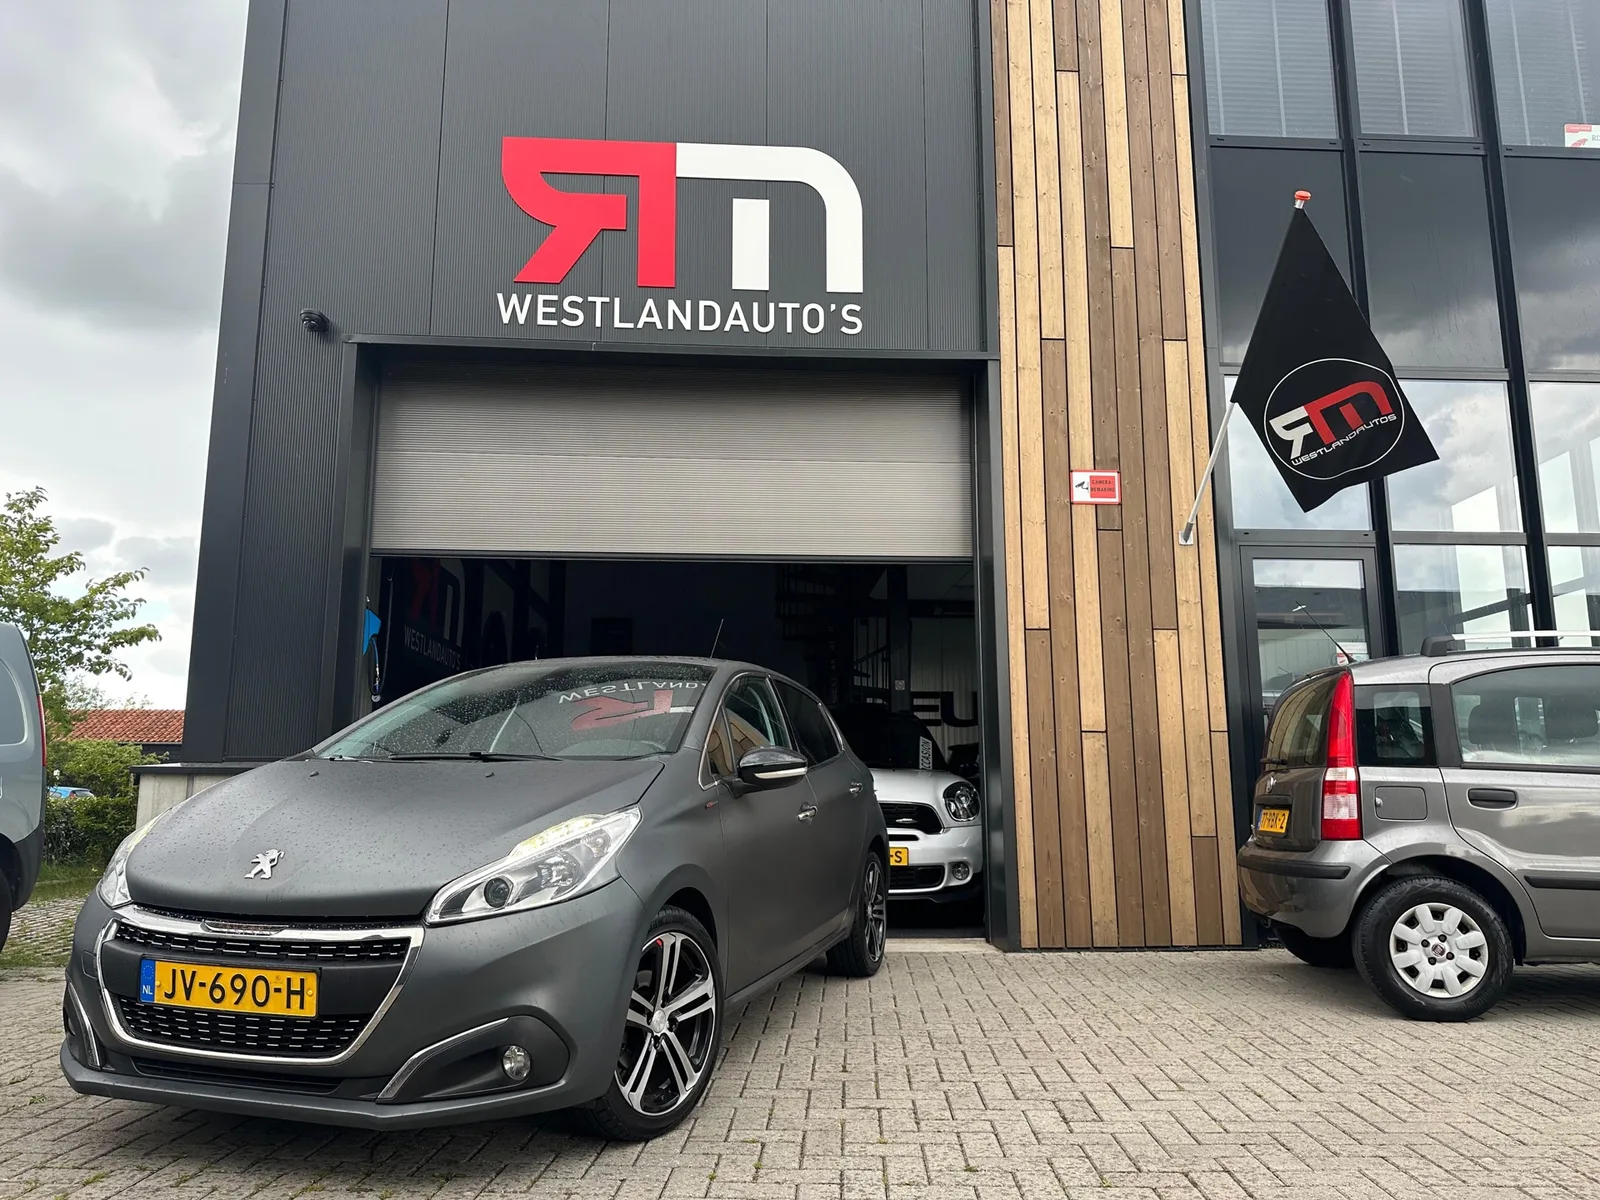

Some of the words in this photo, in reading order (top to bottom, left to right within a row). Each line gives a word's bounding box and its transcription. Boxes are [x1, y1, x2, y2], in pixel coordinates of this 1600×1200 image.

[496, 292, 863, 335] WESTLANDAUTO'S
[1291, 413, 1397, 466] WESTLANDAUTOS
[142, 984, 153, 995] NL
[163, 967, 306, 1010] JV-690-H
